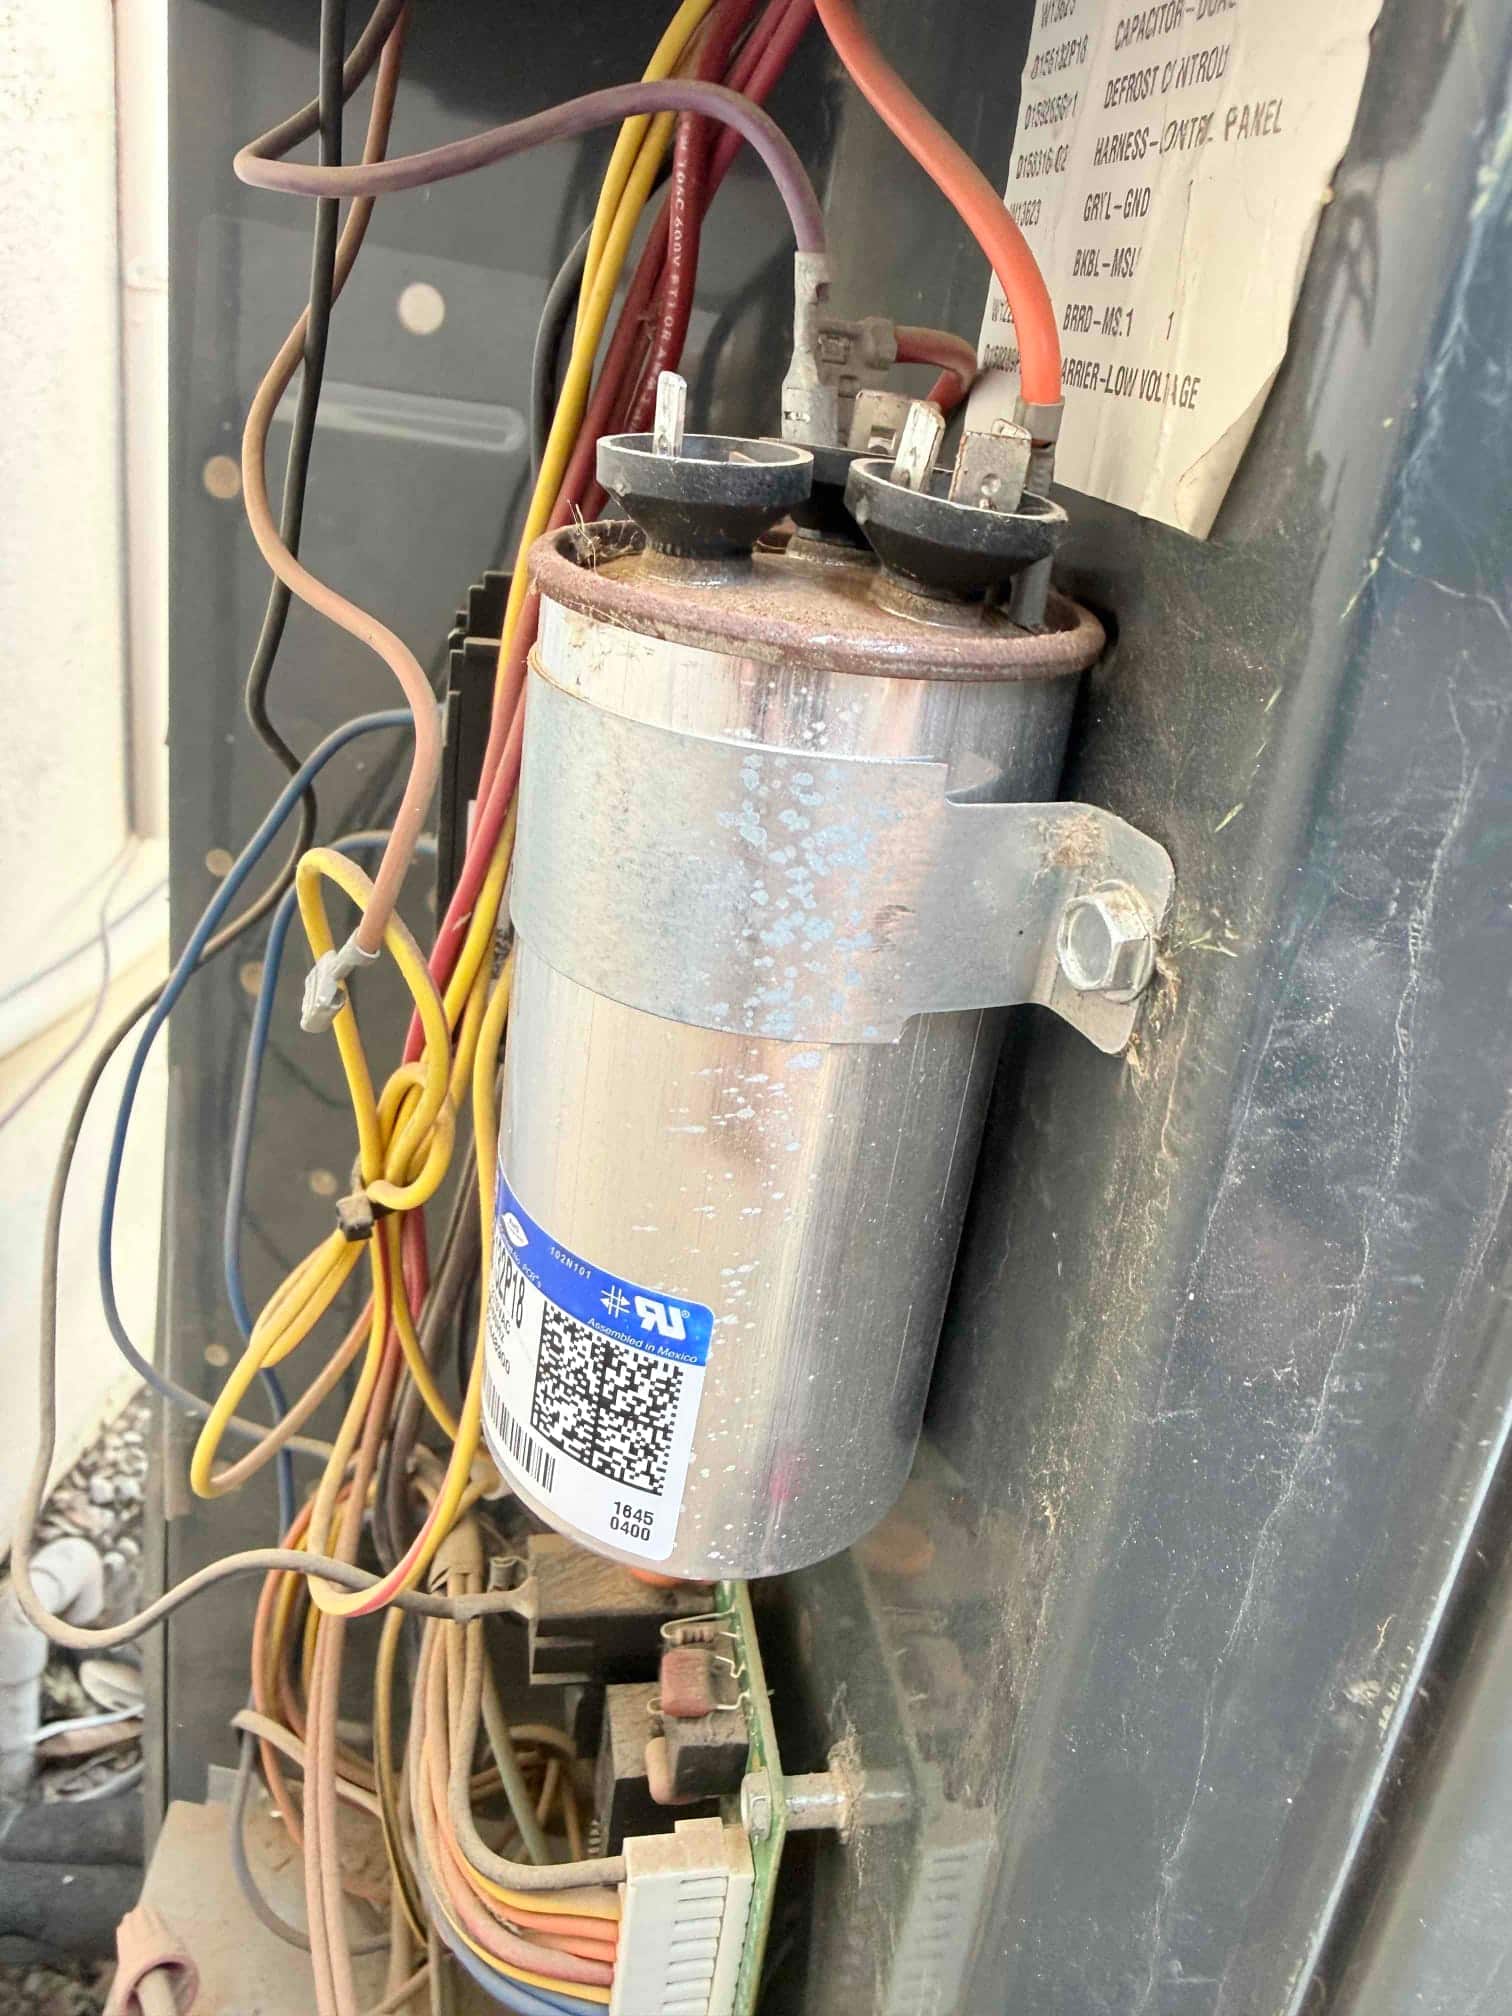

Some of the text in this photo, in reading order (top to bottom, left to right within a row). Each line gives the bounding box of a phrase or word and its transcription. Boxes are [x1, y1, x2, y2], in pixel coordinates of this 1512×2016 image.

[1114, 0, 1236, 51] CAPACITOR-DU
[1103, 65, 1160, 109] DEFROST
[1224, 98, 1282, 142] PANEL
[1061, 357, 1138, 397] ARRIER-LOW
[549, 1246, 592, 1280] 102N101
[587, 1317, 698, 1364] Assembled in Mexico
[610, 1516, 651, 1541] 0400
